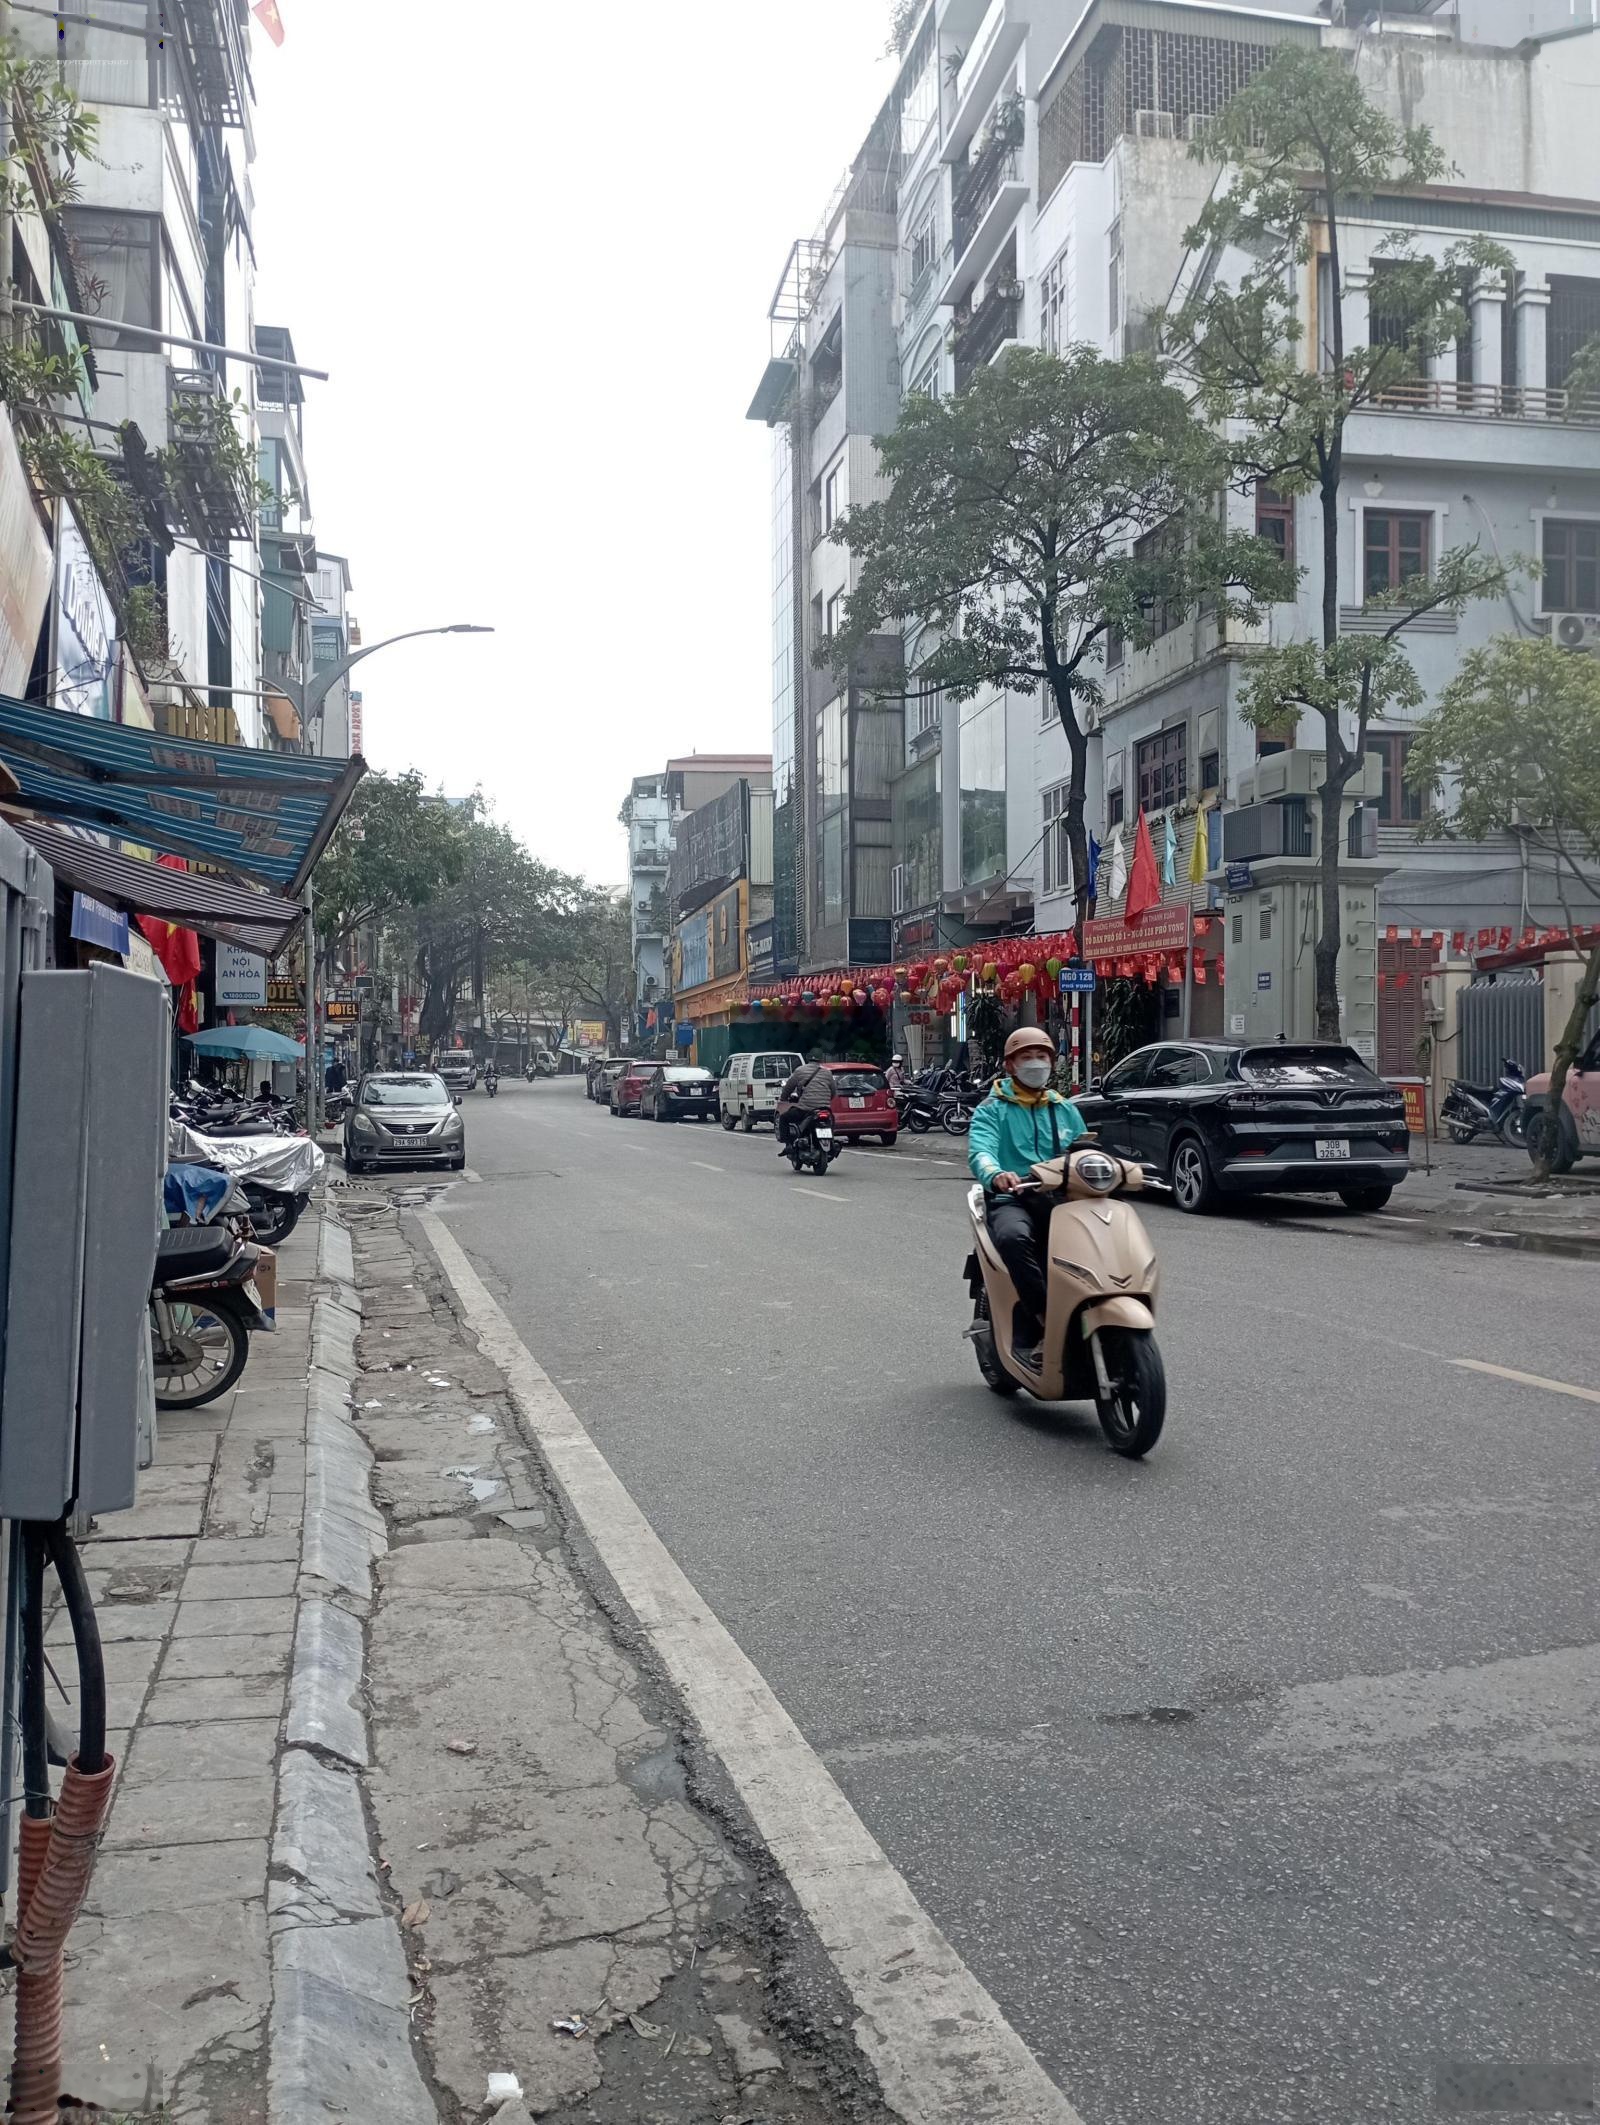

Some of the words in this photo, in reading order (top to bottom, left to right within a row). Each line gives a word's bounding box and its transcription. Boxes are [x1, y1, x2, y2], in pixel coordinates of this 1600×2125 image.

[232, 957, 250, 968] NỘI
[222, 970, 236, 978] AN
[239, 969, 261, 978] HÒA
[1079, 972, 1093, 981] 128
[267, 984, 297, 1000] OTE
[327, 1003, 358, 1015] HOTEL
[908, 1012, 931, 1024] 138
